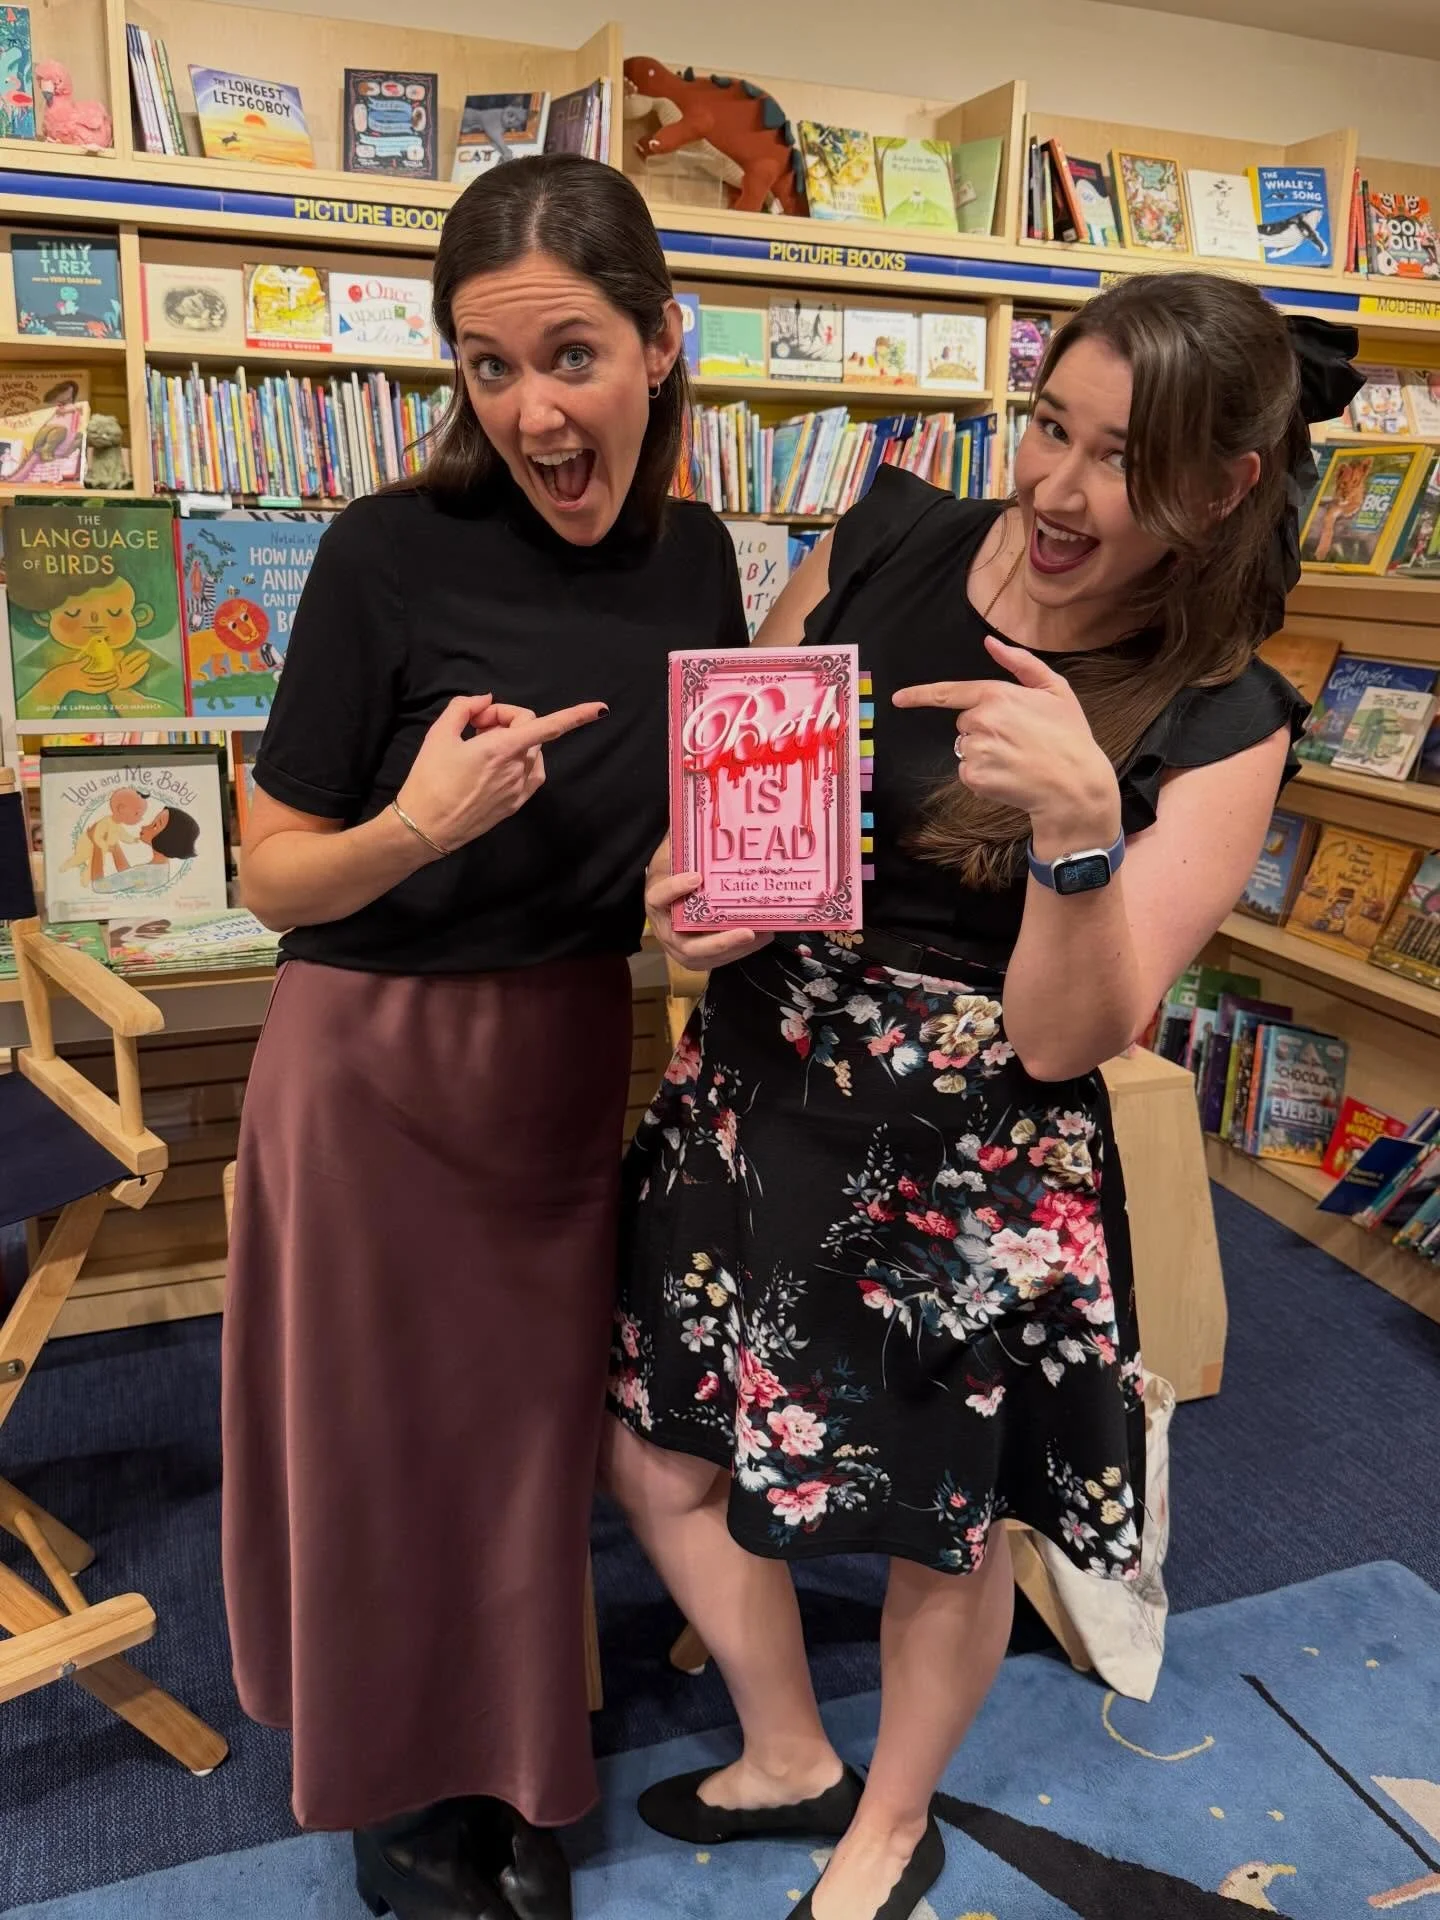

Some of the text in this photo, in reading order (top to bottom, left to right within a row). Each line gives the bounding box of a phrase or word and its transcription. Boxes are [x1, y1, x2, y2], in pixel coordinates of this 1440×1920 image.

[228, 79, 284, 101] LONGEST
[213, 90, 291, 118] LETSGOBOY
[1265, 180, 1315, 191] WHALE'S
[1291, 190, 1323, 202] SONG
[294, 197, 387, 226] PICTURE
[37, 241, 92, 260] TINY
[1390, 235, 1423, 252] OUT
[769, 241, 907, 272] PICTURE BOOKS
[40, 259, 92, 276] T. REX
[365, 280, 413, 304] Once
[1376, 296, 1432, 317] MODERN
[348, 308, 393, 327] upon
[1362, 495, 1392, 512] BIG
[77, 515, 101, 526] THE
[20, 527, 160, 550] LANGUAGE
[23, 553, 115, 576] OF BIRDS
[250, 546, 287, 566] HOW
[263, 593, 285, 608] CAN
[682, 684, 842, 766] Beth
[61, 779, 98, 807] You
[100, 772, 121, 788] and
[156, 769, 200, 806] Baby
[744, 778, 781, 814] IS
[711, 824, 817, 862] DEAD
[719, 877, 812, 892] Katie Bernet
[1279, 1066, 1337, 1089] CHOCOLATE
